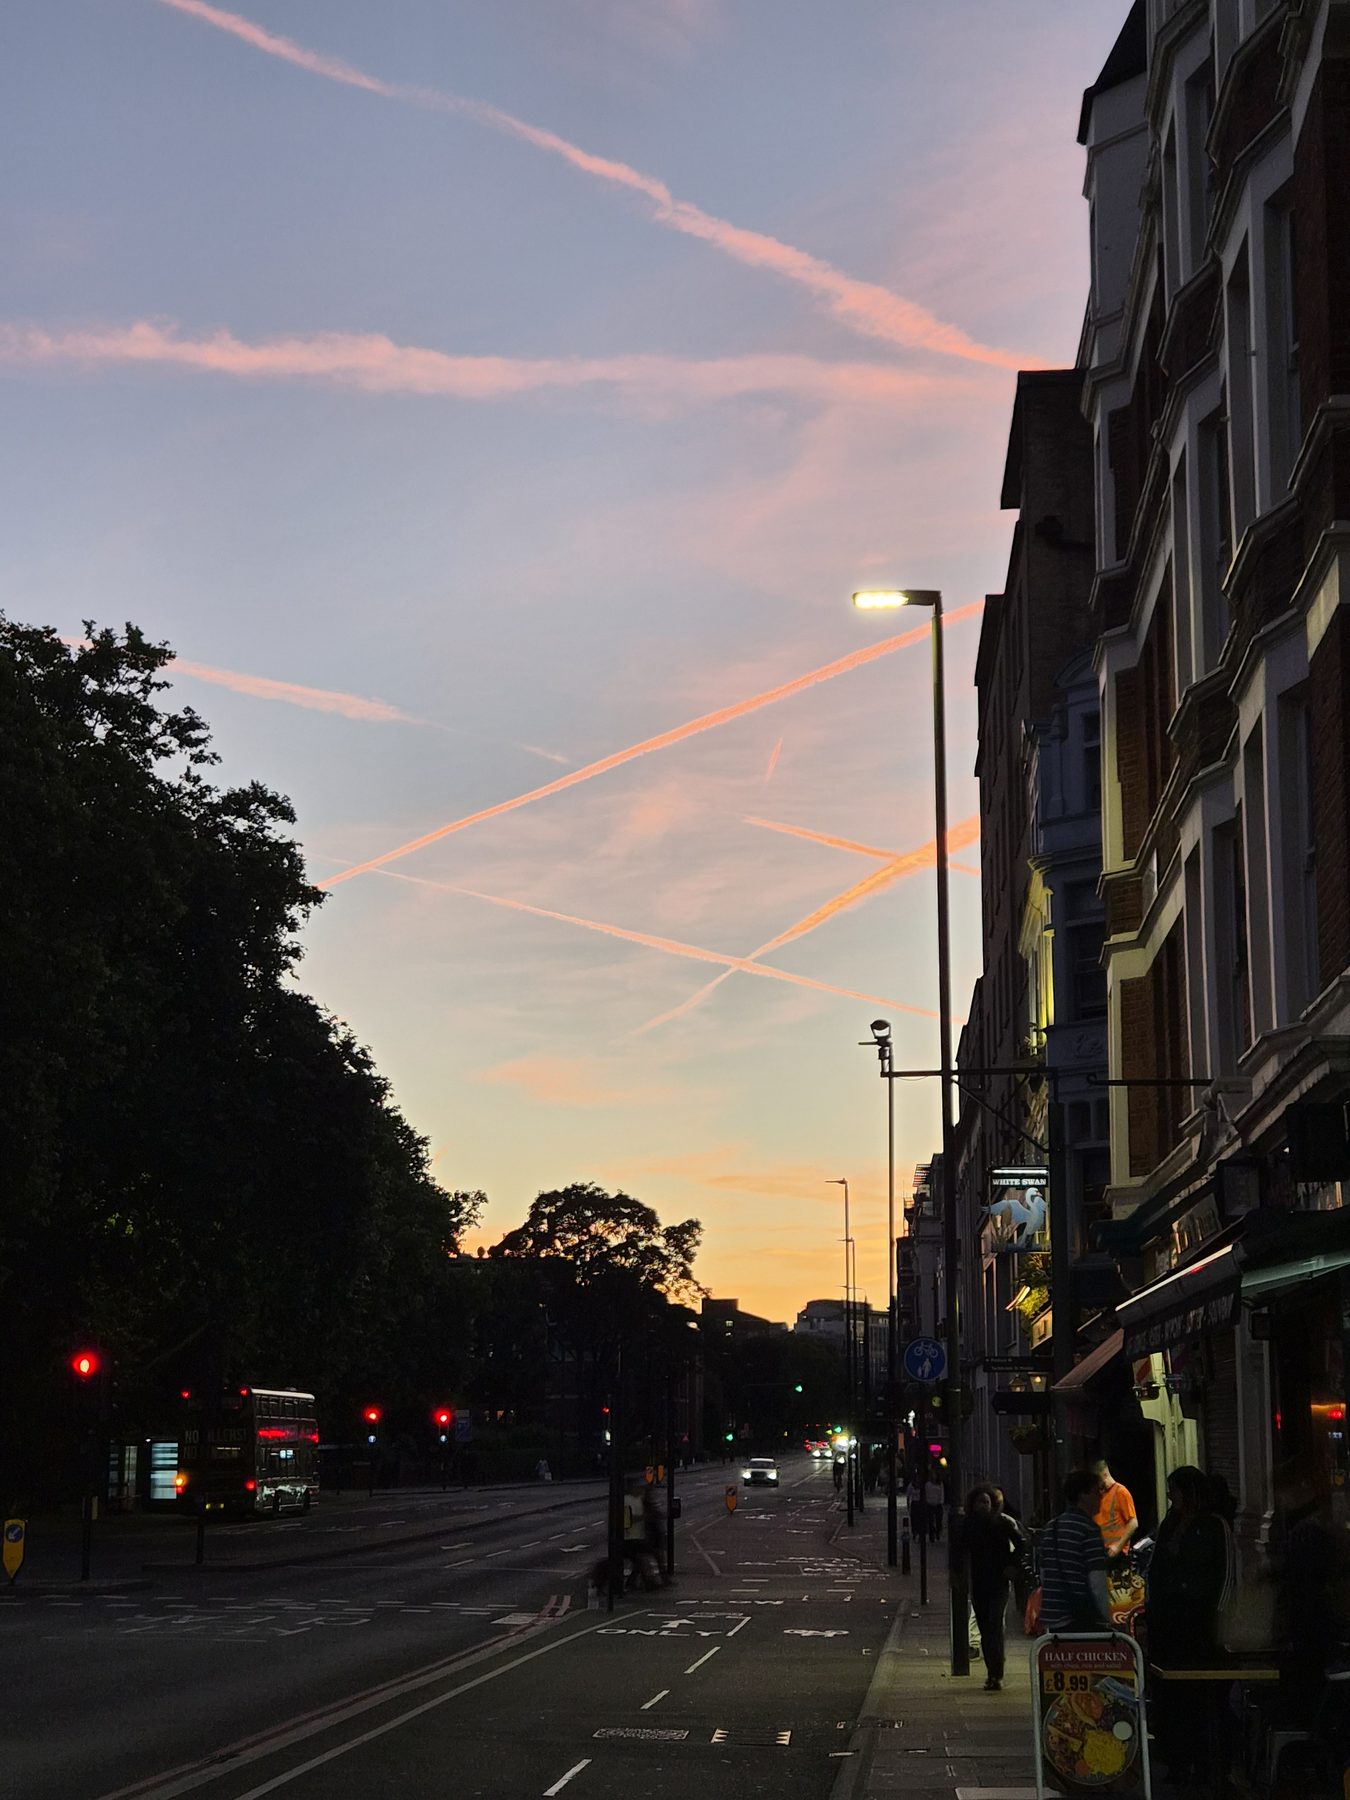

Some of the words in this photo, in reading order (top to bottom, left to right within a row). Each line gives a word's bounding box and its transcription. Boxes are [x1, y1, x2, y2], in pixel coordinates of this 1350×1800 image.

[596, 1628, 722, 1637] ONLY
[1044, 1652, 1073, 1662] HALF
[1076, 1652, 1128, 1662] CHICKEN
[1046, 1671, 1088, 1692] £8.99
